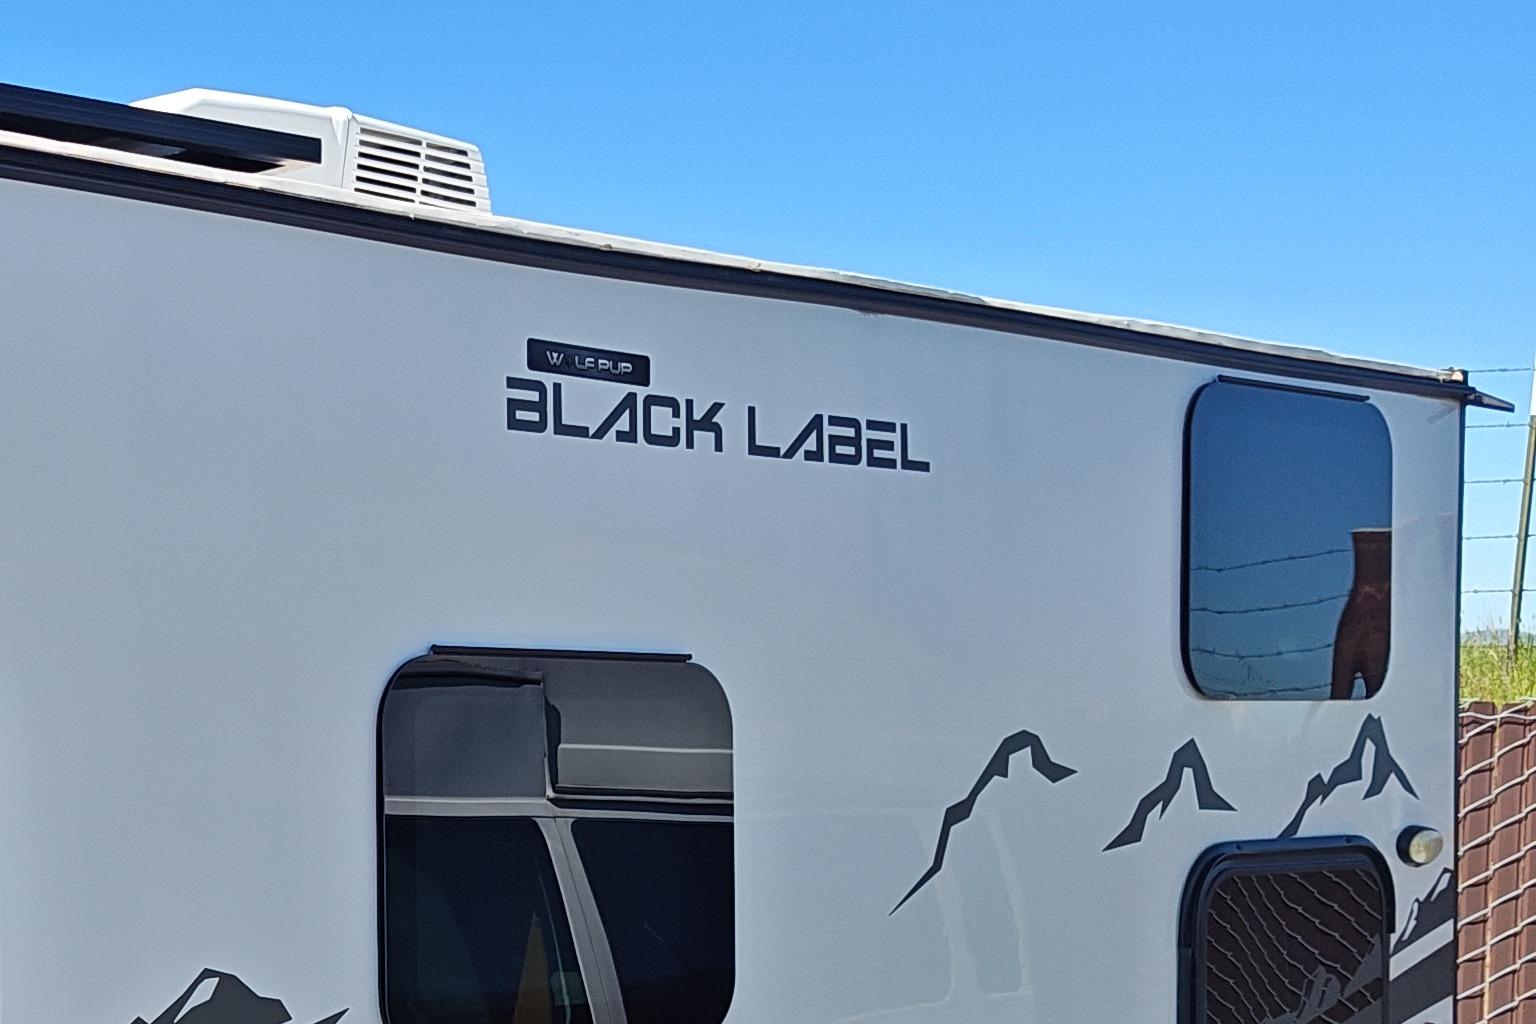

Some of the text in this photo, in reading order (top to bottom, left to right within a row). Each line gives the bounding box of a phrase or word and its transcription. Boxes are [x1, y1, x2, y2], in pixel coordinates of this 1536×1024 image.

[597, 358, 633, 376] PUP
[506, 376, 931, 473] BLACK LABEL
